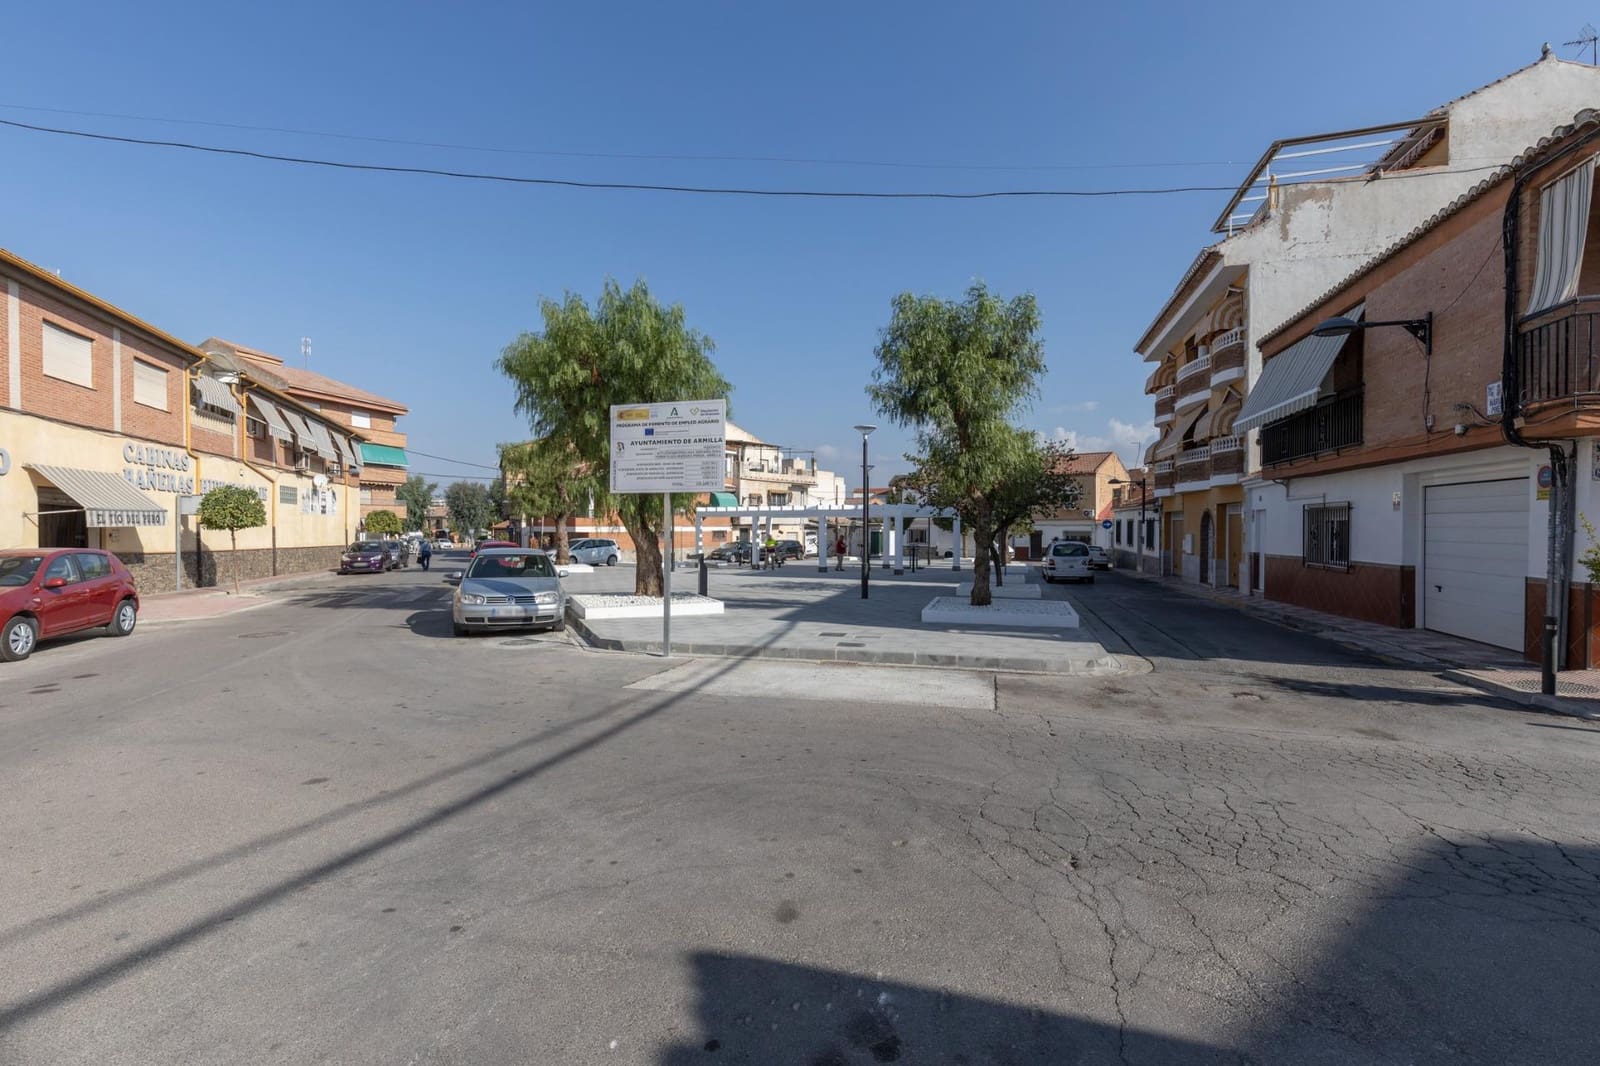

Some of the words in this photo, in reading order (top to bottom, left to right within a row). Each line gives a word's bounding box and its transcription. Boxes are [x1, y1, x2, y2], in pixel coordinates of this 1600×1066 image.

[123, 441, 190, 472] CABINAS
[97, 513, 106, 524] EL
[126, 513, 140, 525] DEL
